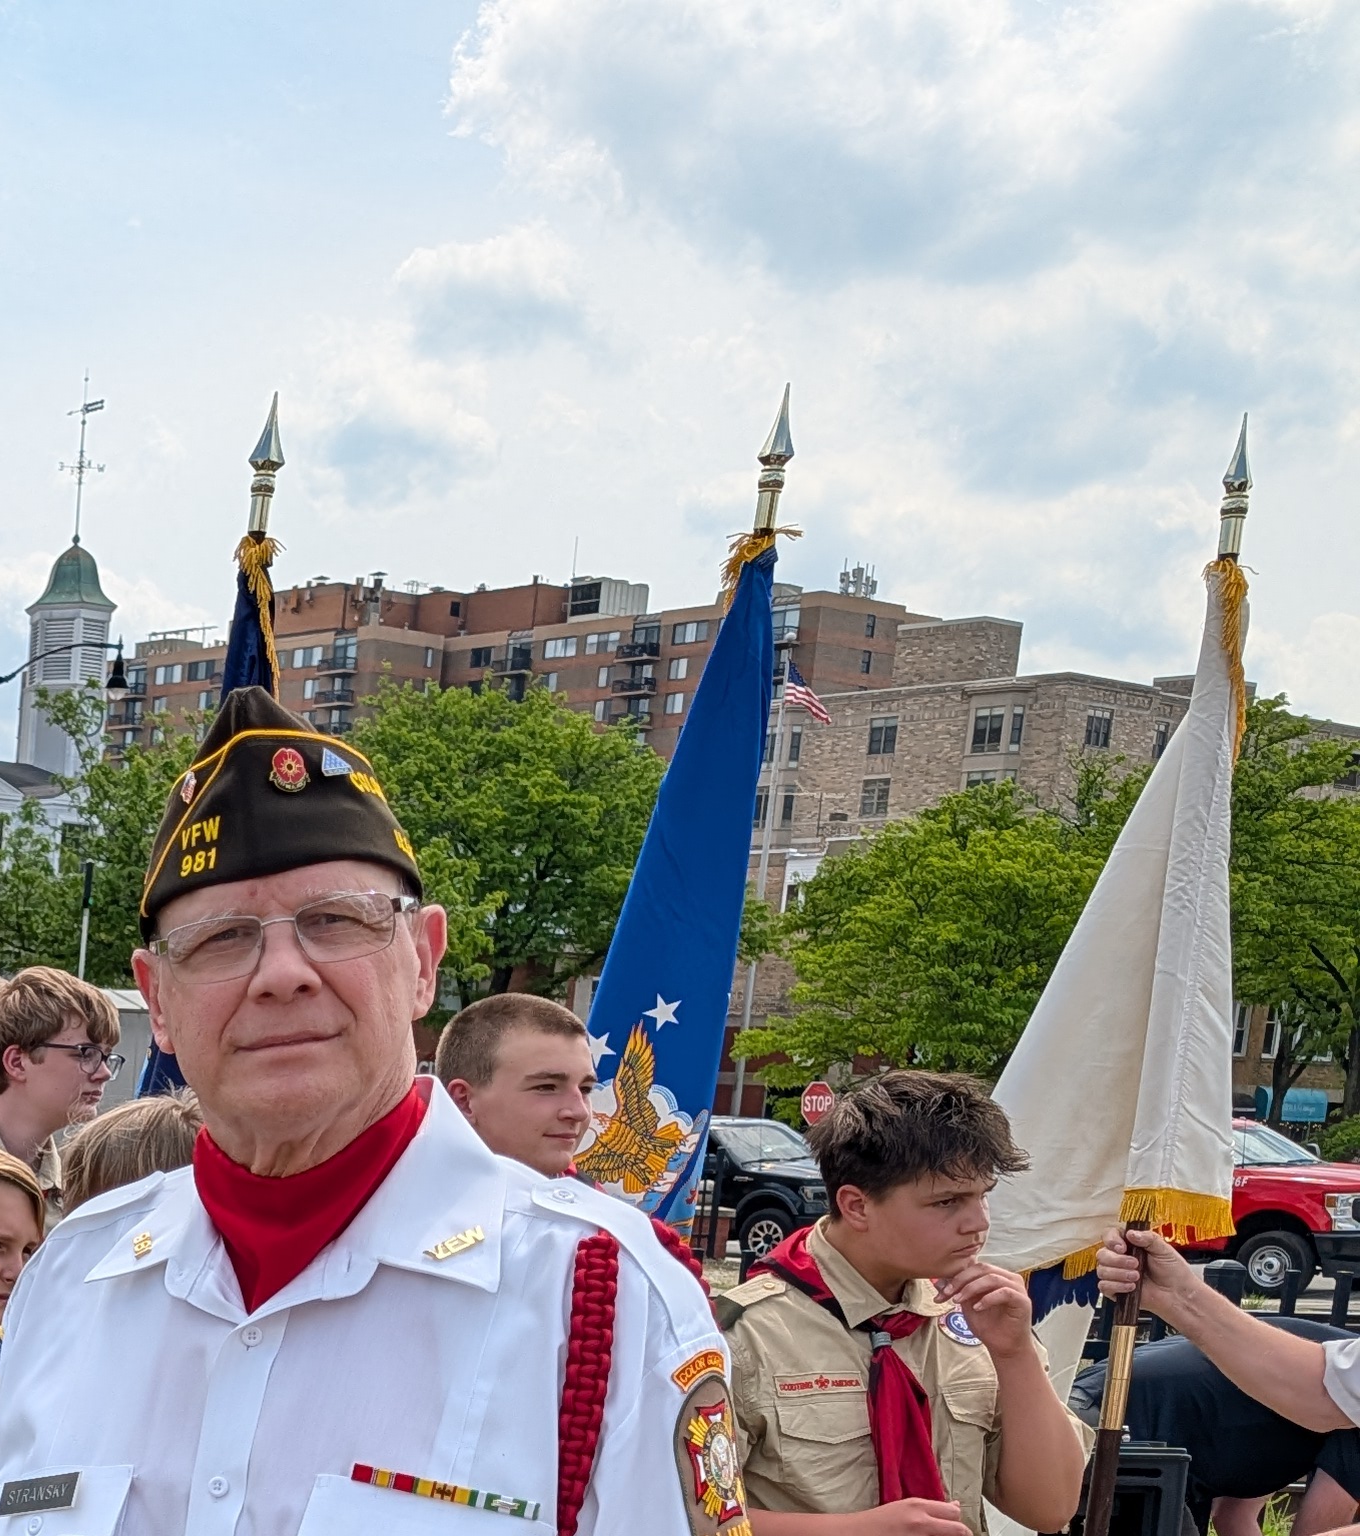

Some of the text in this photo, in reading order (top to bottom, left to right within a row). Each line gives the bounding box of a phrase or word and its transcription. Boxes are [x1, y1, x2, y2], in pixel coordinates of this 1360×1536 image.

[181, 815, 221, 850] VFW
[180, 847, 218, 878] 981
[804, 1095, 831, 1113] STOP
[679, 1357, 706, 1383] COLOR
[6, 1483, 69, 1506] STRANSKY
